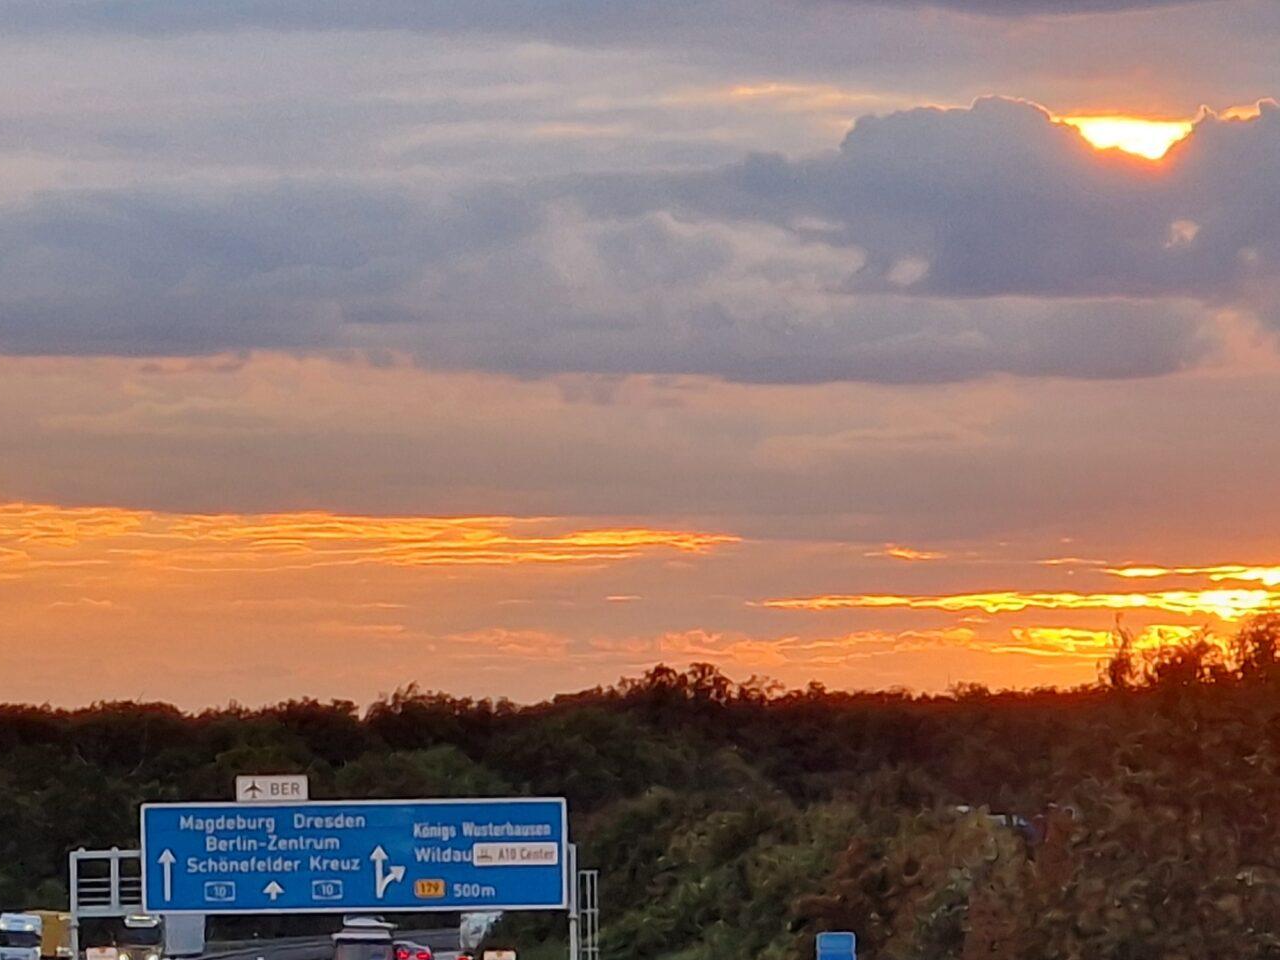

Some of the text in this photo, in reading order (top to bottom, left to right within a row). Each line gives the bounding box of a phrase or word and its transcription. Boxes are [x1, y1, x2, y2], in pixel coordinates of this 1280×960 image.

[270, 783, 300, 796] BER
[180, 814, 365, 833] Magdeburg Dresden
[413, 822, 551, 840] Königs Wusterhausen
[206, 835, 340, 852] Berlin-Zentrum
[415, 848, 472, 863] Wildau
[498, 848, 554, 860] A10 Center
[187, 857, 360, 873] Schönefelder Kreuz
[215, 886, 226, 898] 10
[322, 884, 333, 896] 10
[453, 883, 495, 897] 500m
